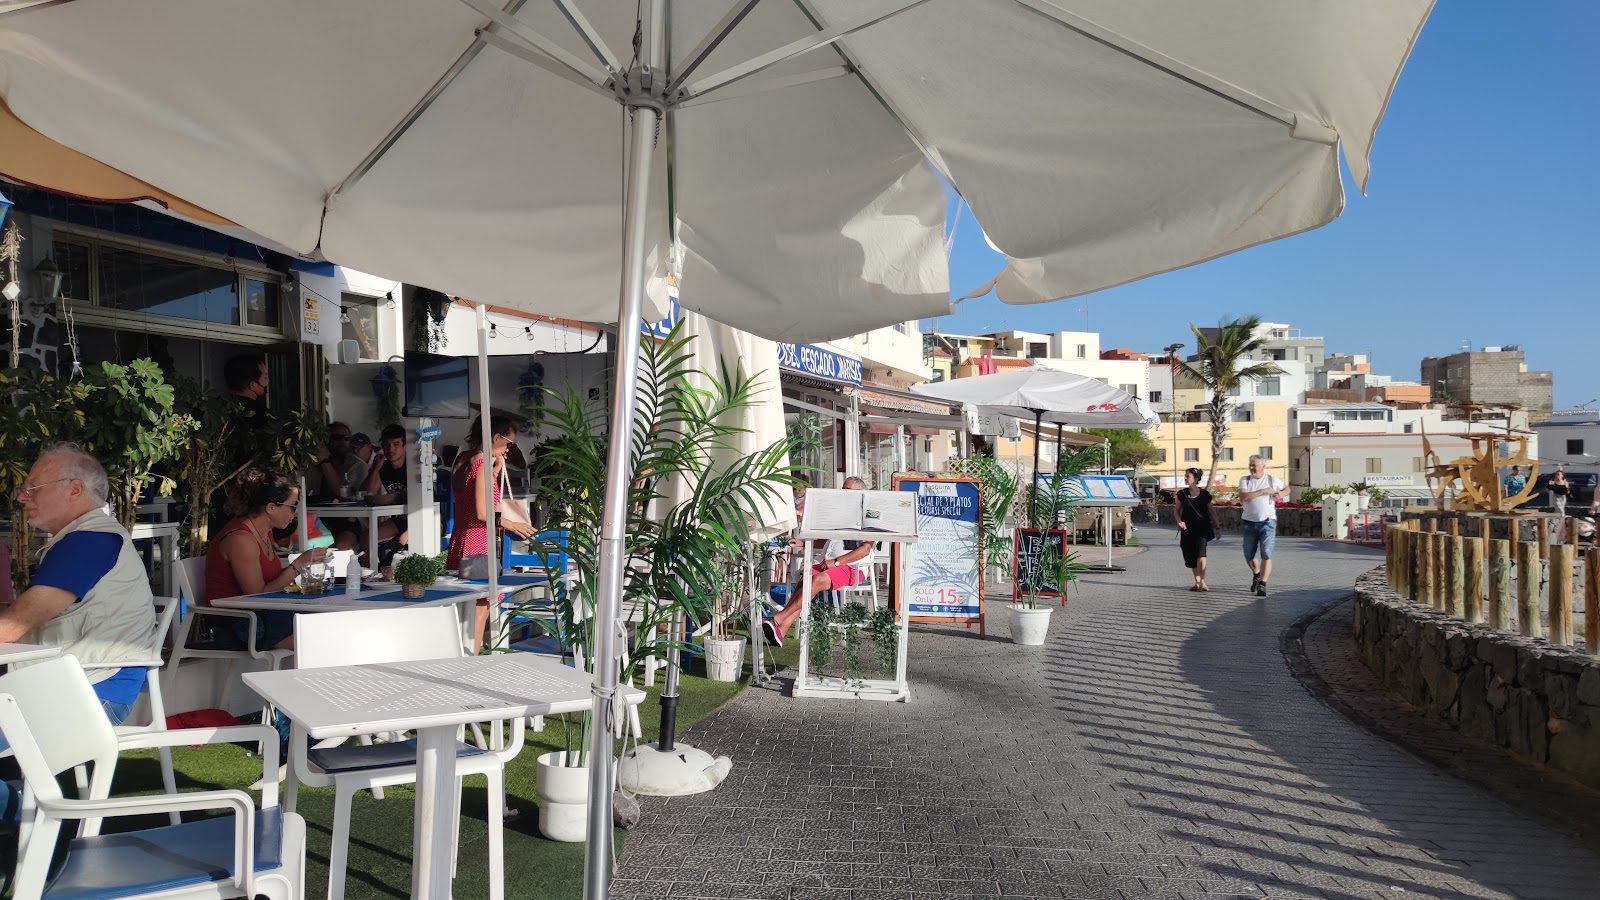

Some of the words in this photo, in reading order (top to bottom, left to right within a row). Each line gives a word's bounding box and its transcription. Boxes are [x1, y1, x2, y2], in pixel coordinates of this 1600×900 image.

[307, 321, 317, 331] 32
[800, 346, 835, 377] PESCADO
[935, 497, 943, 507] DE
[949, 496, 972, 508] PLATOS
[941, 507, 962, 516] SPECIAL
